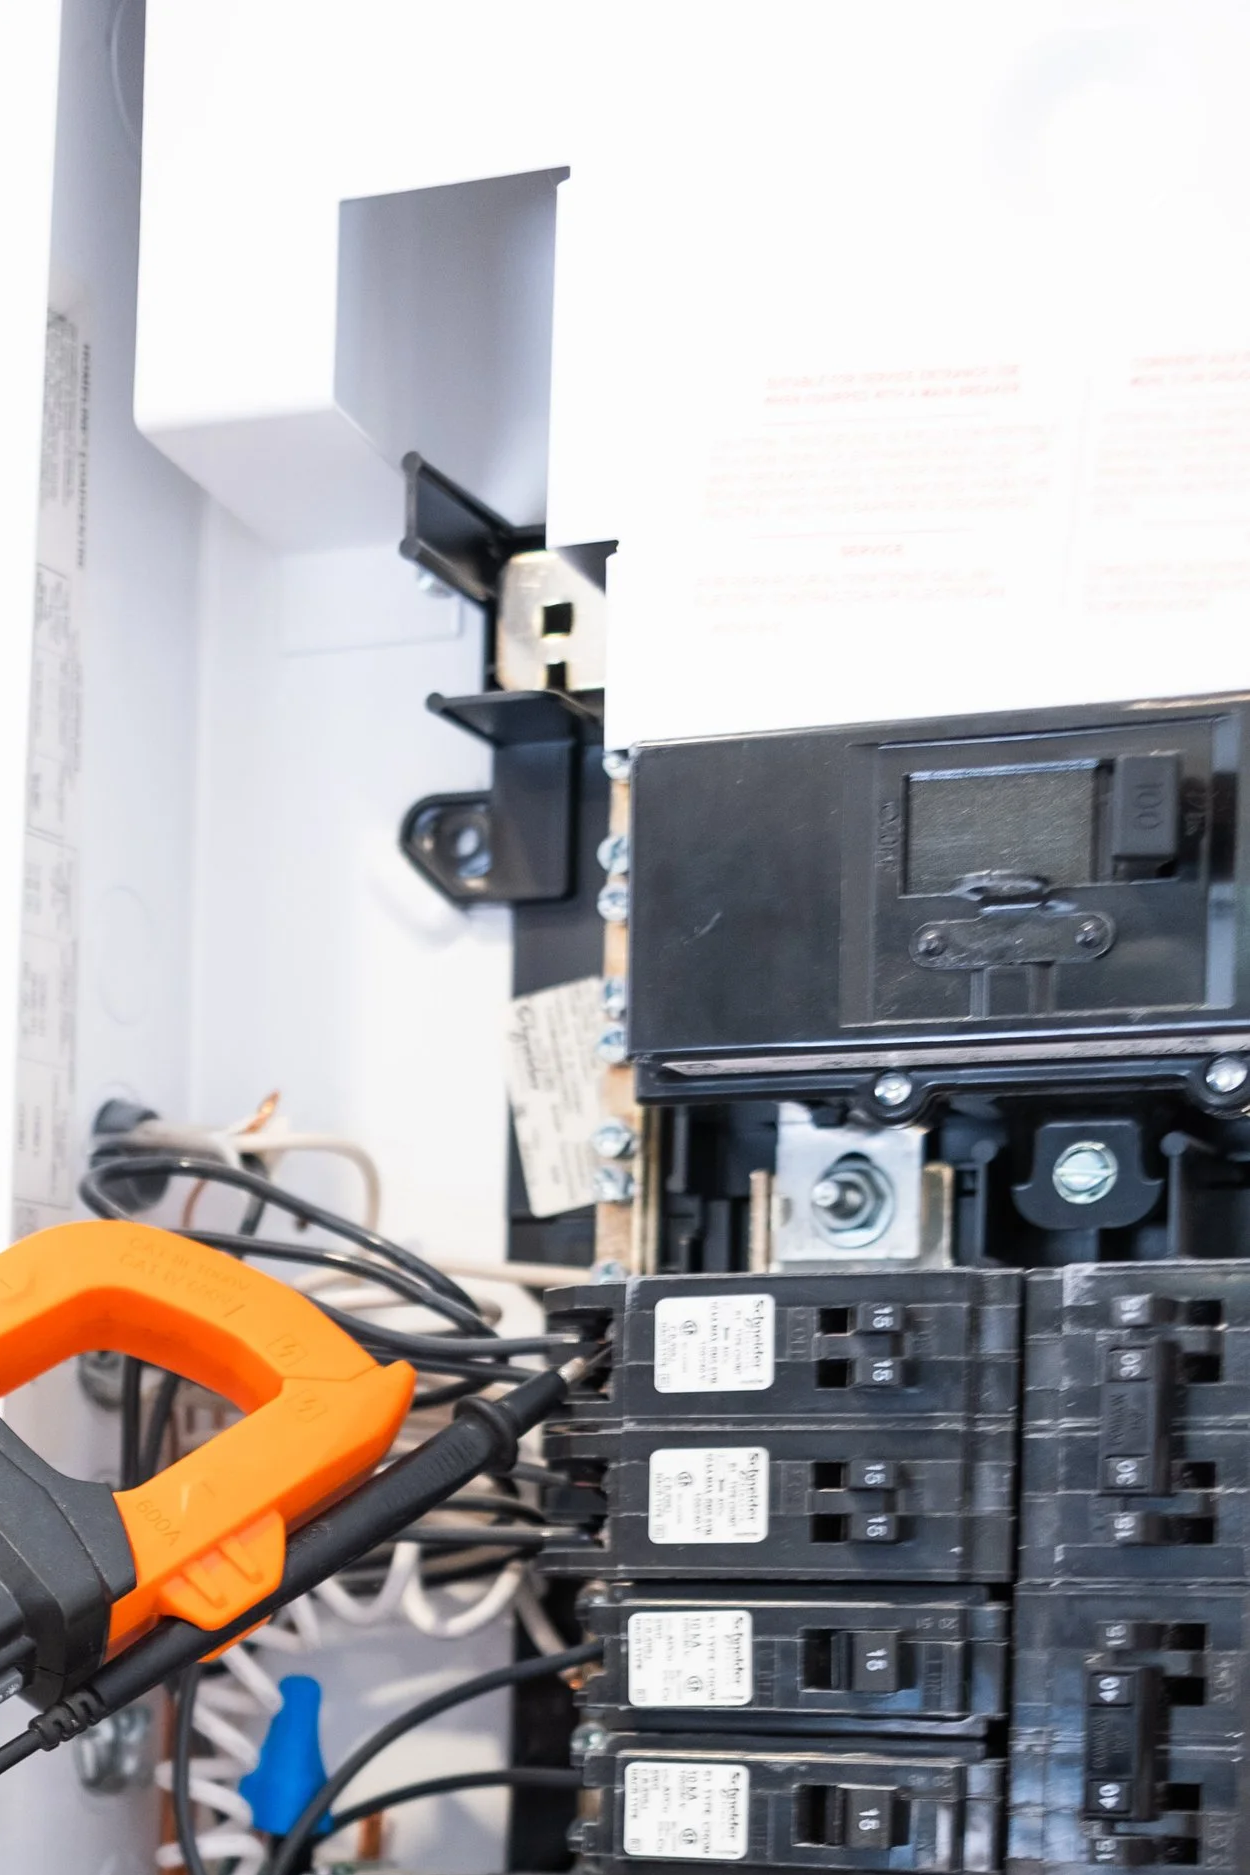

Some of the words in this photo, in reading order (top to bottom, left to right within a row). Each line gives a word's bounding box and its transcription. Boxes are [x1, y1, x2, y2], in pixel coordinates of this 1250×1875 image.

[872, 1305, 894, 1329] 15
[871, 1358, 894, 1382] 15
[864, 1464, 887, 1486] 15
[866, 1515, 889, 1538] 15
[865, 1648, 888, 1671] 15
[1098, 1677, 1121, 1702] 40
[1098, 1784, 1121, 1808] 40
[858, 1808, 880, 1831] 15
[1096, 1840, 1116, 1861] 15
